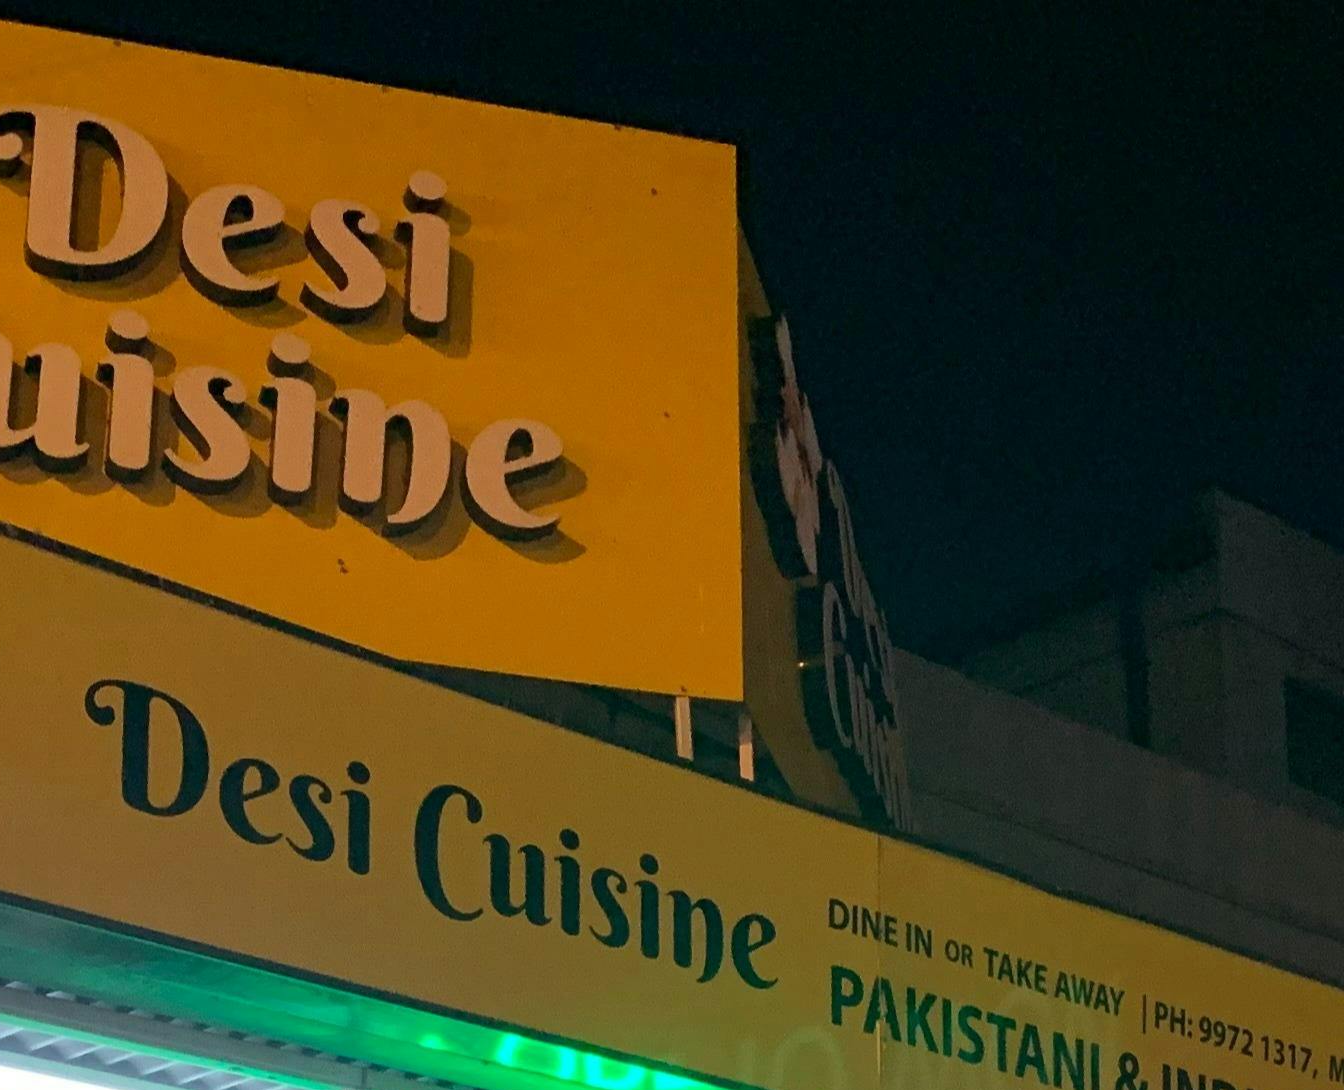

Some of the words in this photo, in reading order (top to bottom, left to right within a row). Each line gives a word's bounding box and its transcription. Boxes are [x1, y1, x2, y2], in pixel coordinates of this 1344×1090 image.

[83, 679, 371, 876] Desi
[413, 783, 779, 990] Cuisine
[827, 898, 898, 948] DINE
[905, 922, 933, 958] IN
[944, 938, 975, 969] OR
[983, 946, 1048, 995] TAKE
[1055, 970, 1126, 1017] AWAY
[1198, 1015, 1254, 1057] 9972
[1260, 1035, 1319, 1079] 1317,
